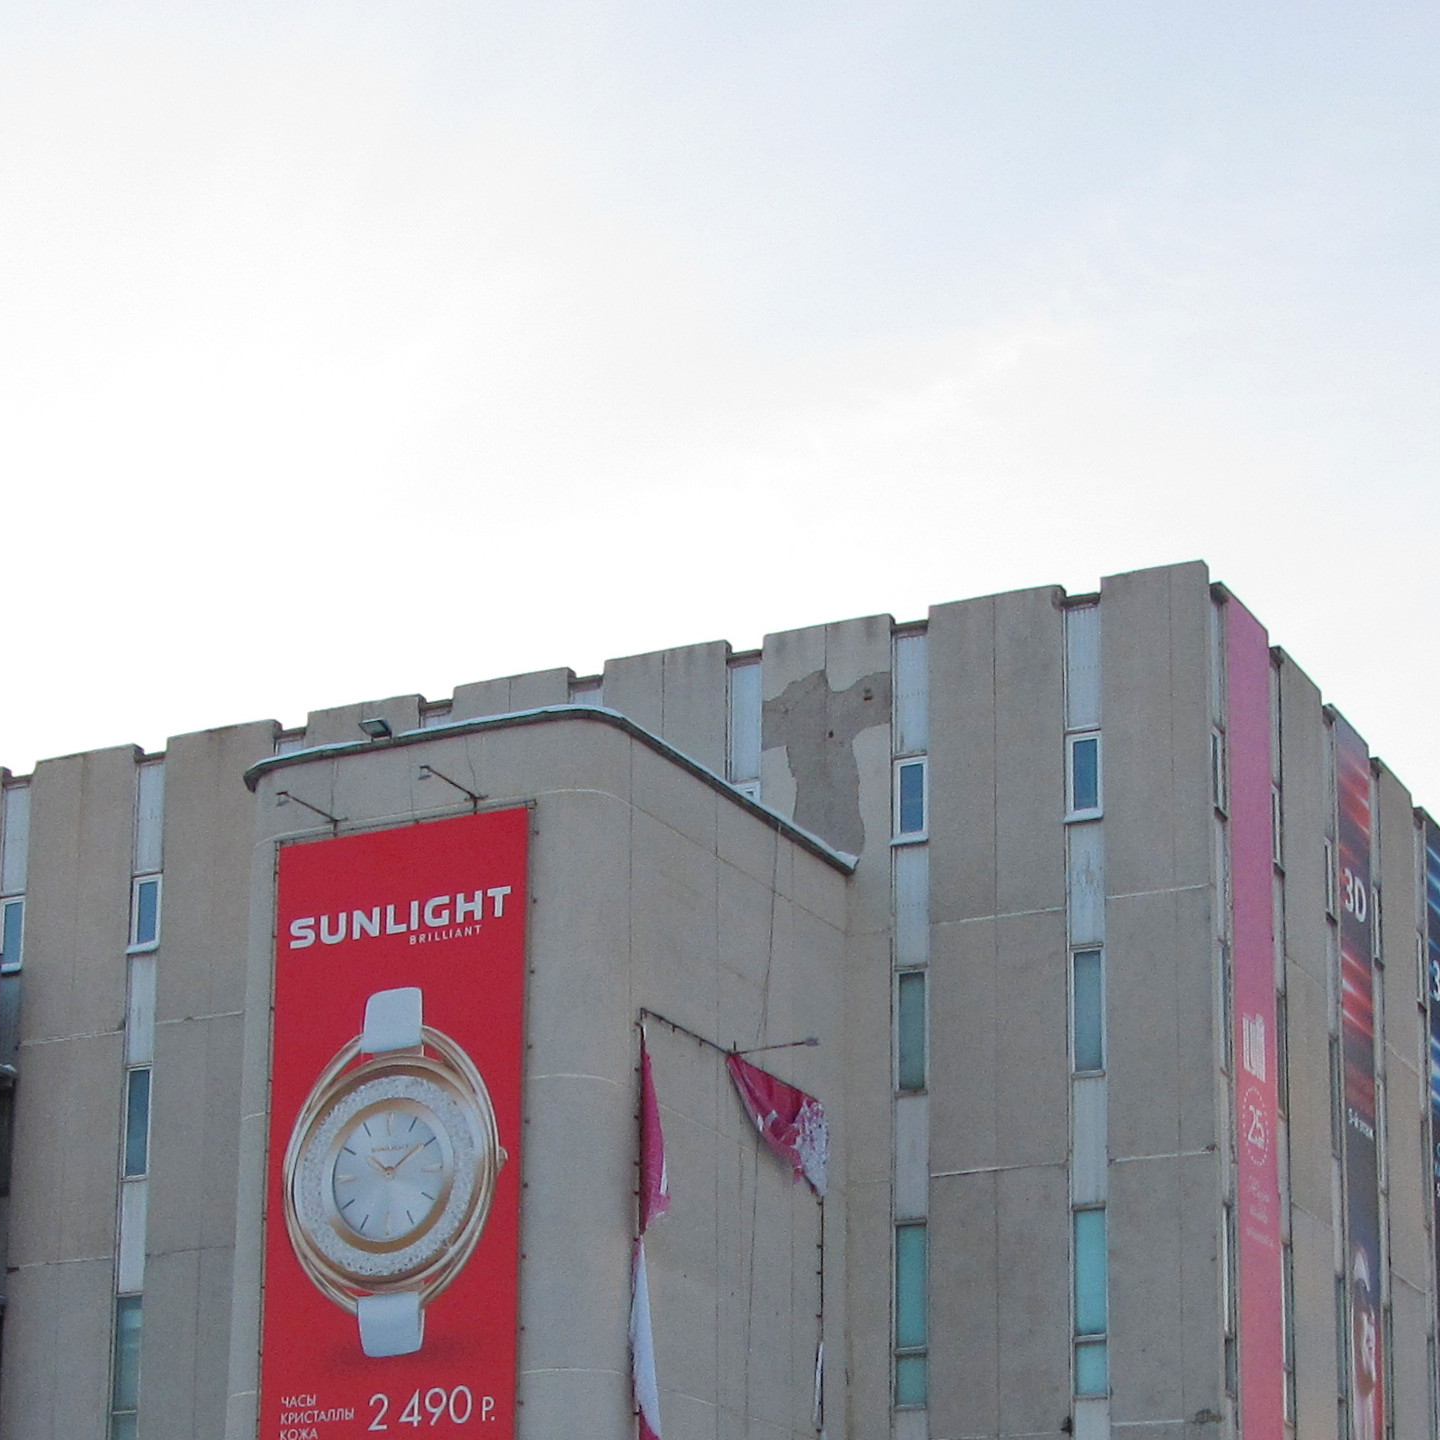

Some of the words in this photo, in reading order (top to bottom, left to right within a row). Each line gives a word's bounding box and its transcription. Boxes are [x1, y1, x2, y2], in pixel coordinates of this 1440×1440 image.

[1345, 868, 1366, 922] 3D
[289, 885, 512, 949] SUNLIGHT
[409, 924, 481, 945] BRILLIANT
[281, 1394, 316, 1408] ЧАСЫ
[280, 1407, 355, 1425] КРИСТАЛЛЫ
